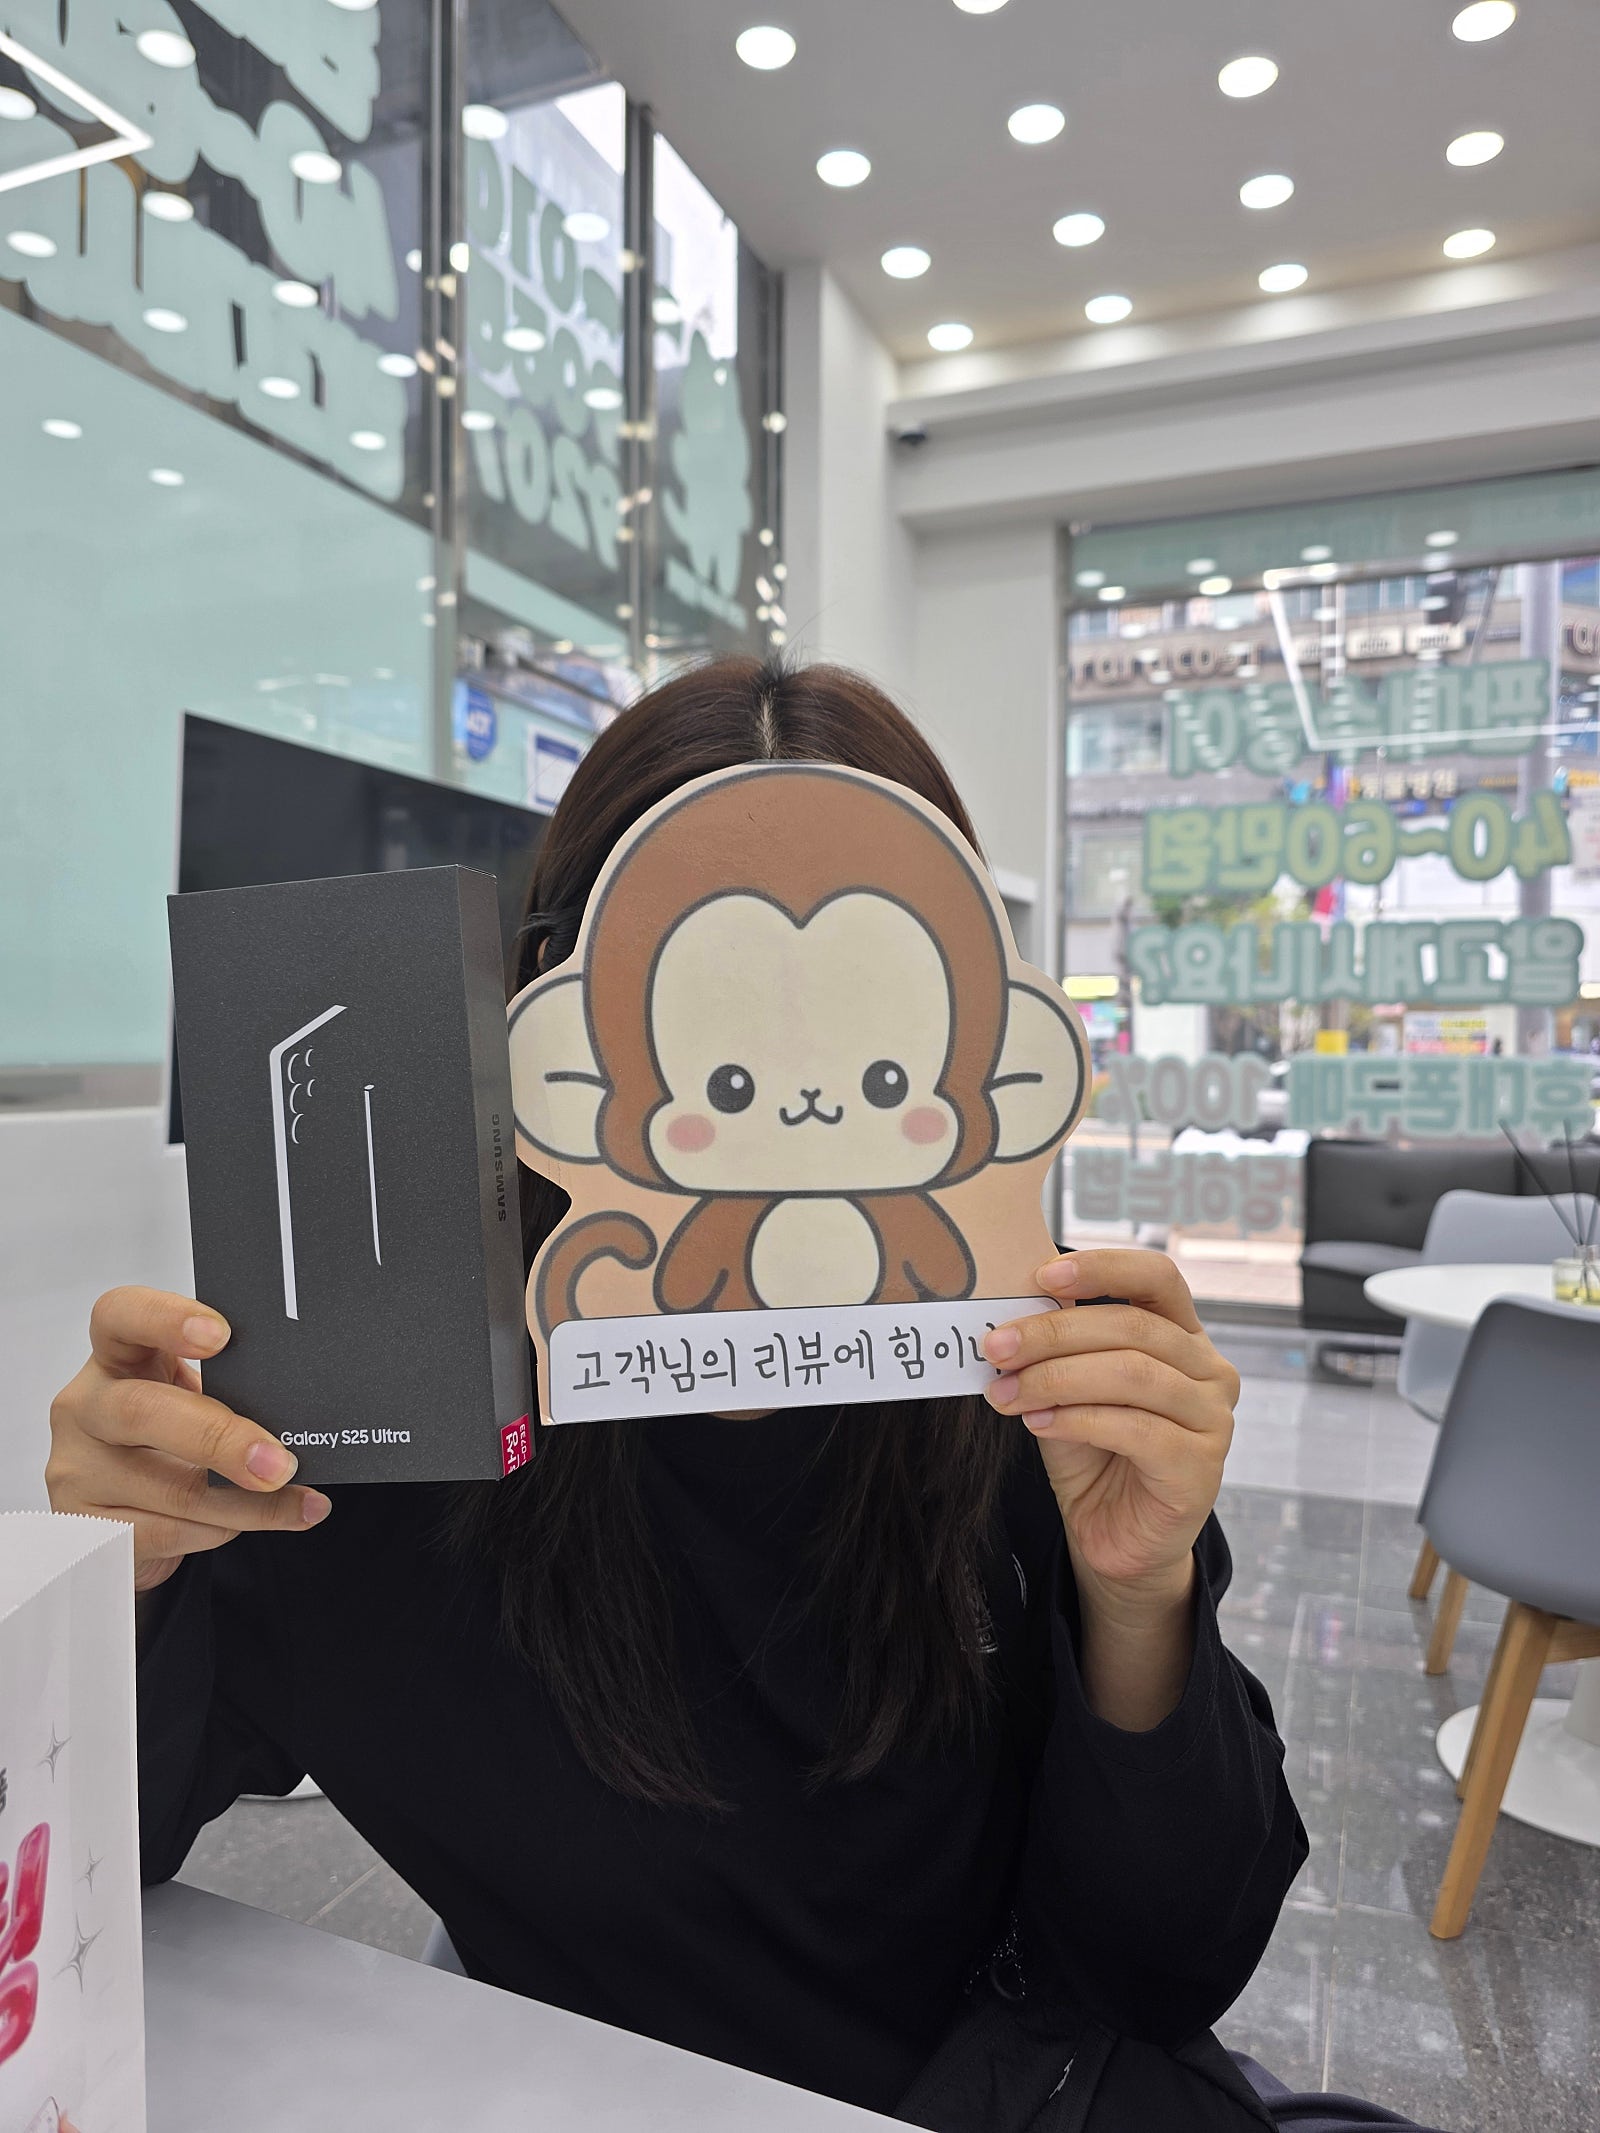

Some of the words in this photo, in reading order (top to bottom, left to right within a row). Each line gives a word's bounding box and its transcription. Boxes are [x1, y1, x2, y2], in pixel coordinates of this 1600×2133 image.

[492, 1113, 506, 1222] SAMSUNG
[573, 1337, 737, 1394] 고객님의
[754, 1328, 875, 1388] 리뷰에
[280, 1430, 338, 1449] Galaxy
[341, 1429, 369, 1445] S25
[371, 1428, 411, 1444] Ultra
